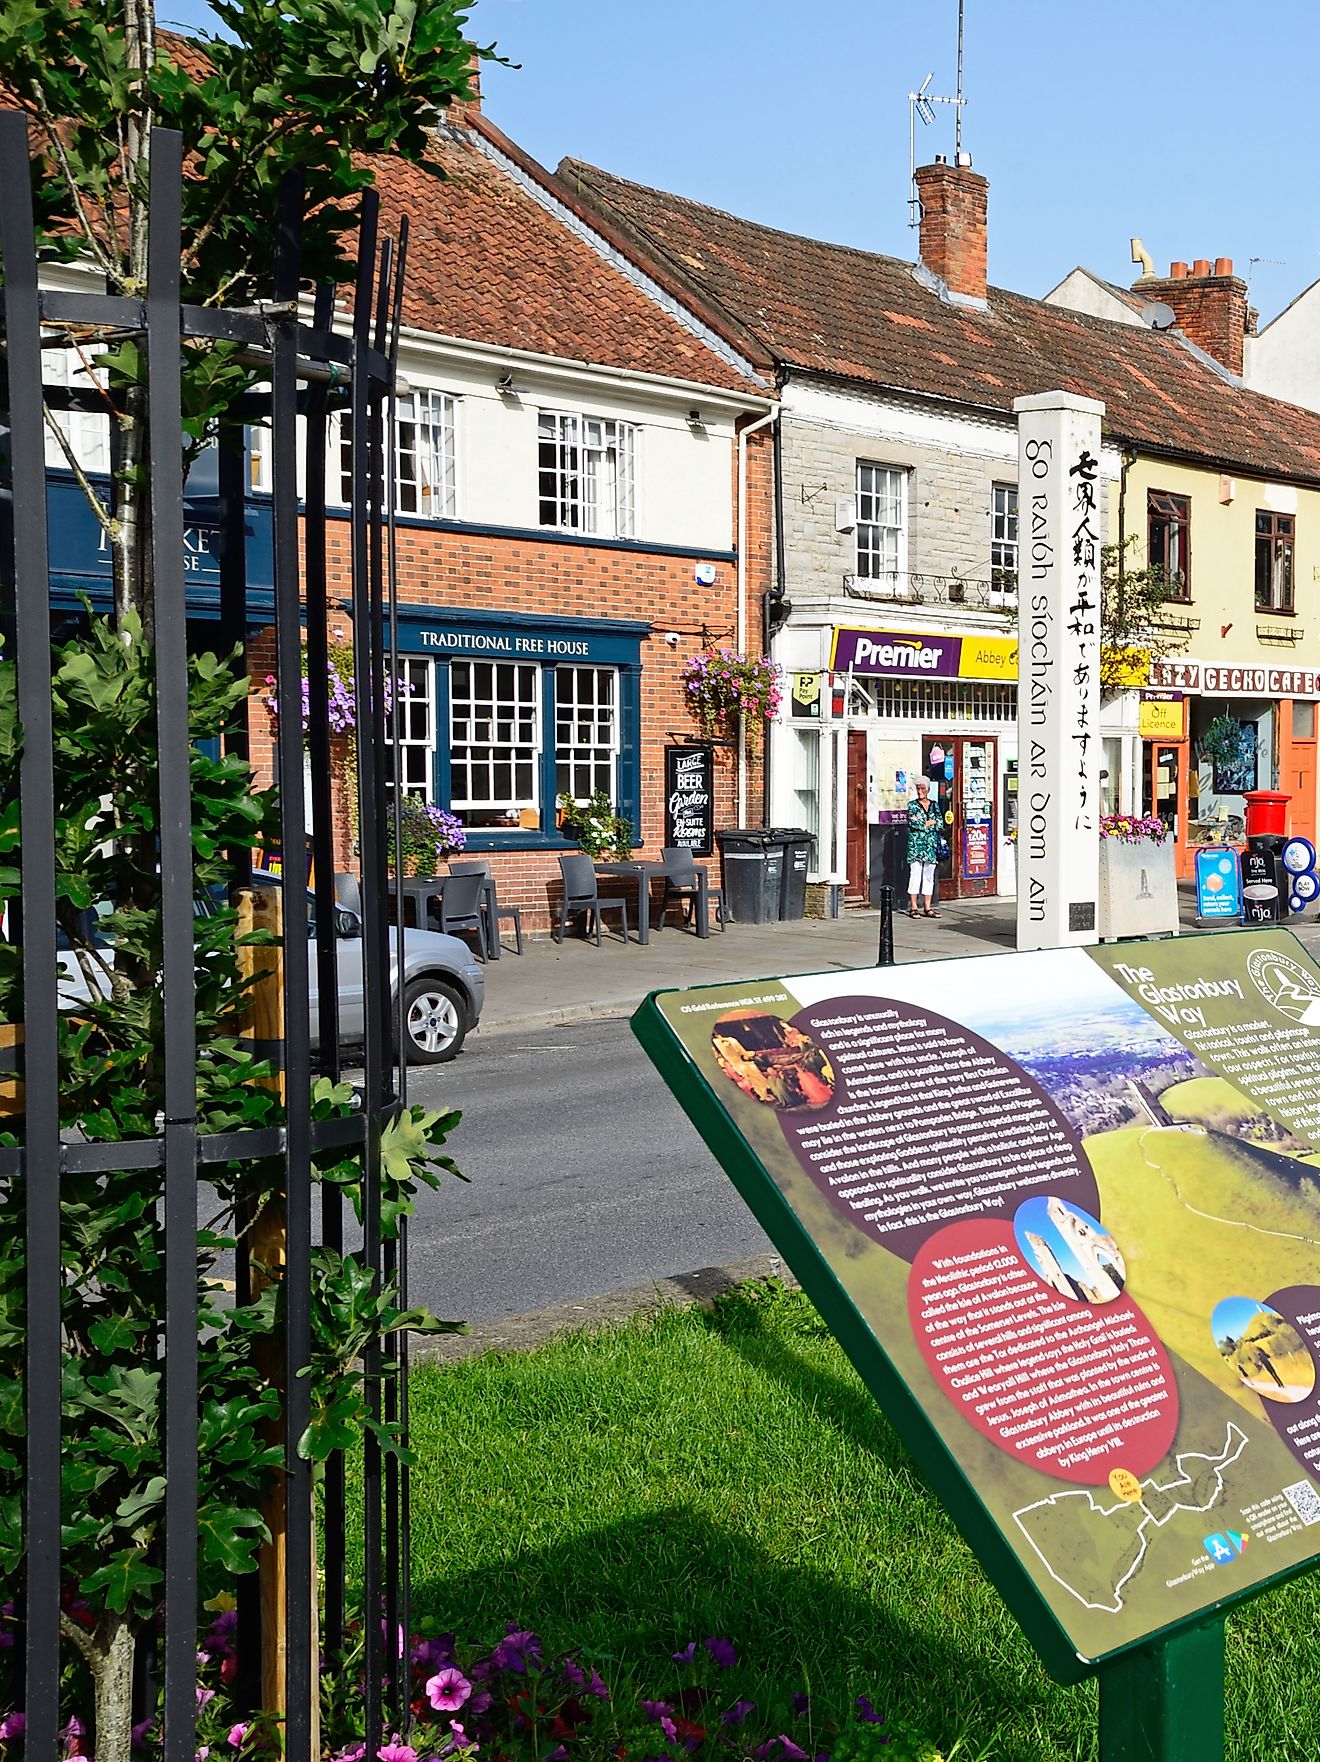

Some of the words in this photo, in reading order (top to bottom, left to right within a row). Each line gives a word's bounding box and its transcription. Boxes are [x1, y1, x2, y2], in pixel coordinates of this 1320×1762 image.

[420, 631, 511, 651] TRADITIONAL
[515, 637, 544, 654] FREE
[547, 639, 589, 656] HOUSE
[1068, 451, 1099, 830] 世界人類が平和でありますように
[854, 637, 943, 670] Premier
[976, 650, 1007, 668] Abbey
[1149, 665, 1199, 688] LAZY
[1205, 668, 1265, 692] GECKO
[1269, 671, 1313, 694] CAFE
[1145, 692, 1174, 701] Premier
[1151, 708, 1167, 719] Off
[1142, 719, 1176, 729] Licence
[677, 755, 702, 770] LARGE
[677, 774, 703, 790] BEER
[669, 791, 708, 820] Garden
[1113, 963, 1155, 983] The
[1251, 953, 1297, 977] Glastonbury
[1257, 980, 1275, 1001] The
[1301, 970, 1320, 993] Way
[1139, 979, 1243, 1009] Glastonbury
[705, 1001, 740, 1010] Reference
[810, 1016, 857, 1028] Glastonbury
[863, 1009, 899, 1021] unusually
[1156, 1005, 1206, 1027] Way
[820, 1029, 836, 1039] rich
[841, 1025, 873, 1037] legends
[872, 1022, 888, 1032] and
[887, 1019, 927, 1030] mythology
[1183, 1027, 1231, 1040] Glastonbury
[1234, 1034, 1260, 1045] tourist
[1259, 1031, 1276, 1042] and
[1274, 1028, 1310, 1041] pilgrimage
[828, 1041, 845, 1051] and
[857, 1035, 894, 1047] significant
[894, 1032, 915, 1043] place
[925, 1028, 947, 1036] many
[1232, 1048, 1251, 1058] This
[1249, 1044, 1271, 1055] walk
[1269, 1042, 1293, 1053] offers
[1223, 1064, 1243, 1073] four
[1274, 1055, 1290, 1065] For
[1238, 1071, 1269, 1085] spiritual
[1296, 1065, 1314, 1074] The
[932, 1258, 955, 1269] With
[953, 1248, 1000, 1264] foundations
[922, 1278, 937, 1288] the
[935, 1269, 970, 1284] Neolithic
[969, 1262, 994, 1277] period
[1112, 1472, 1128, 1481] You
[1166, 1572, 1195, 1588] Glastonbury
